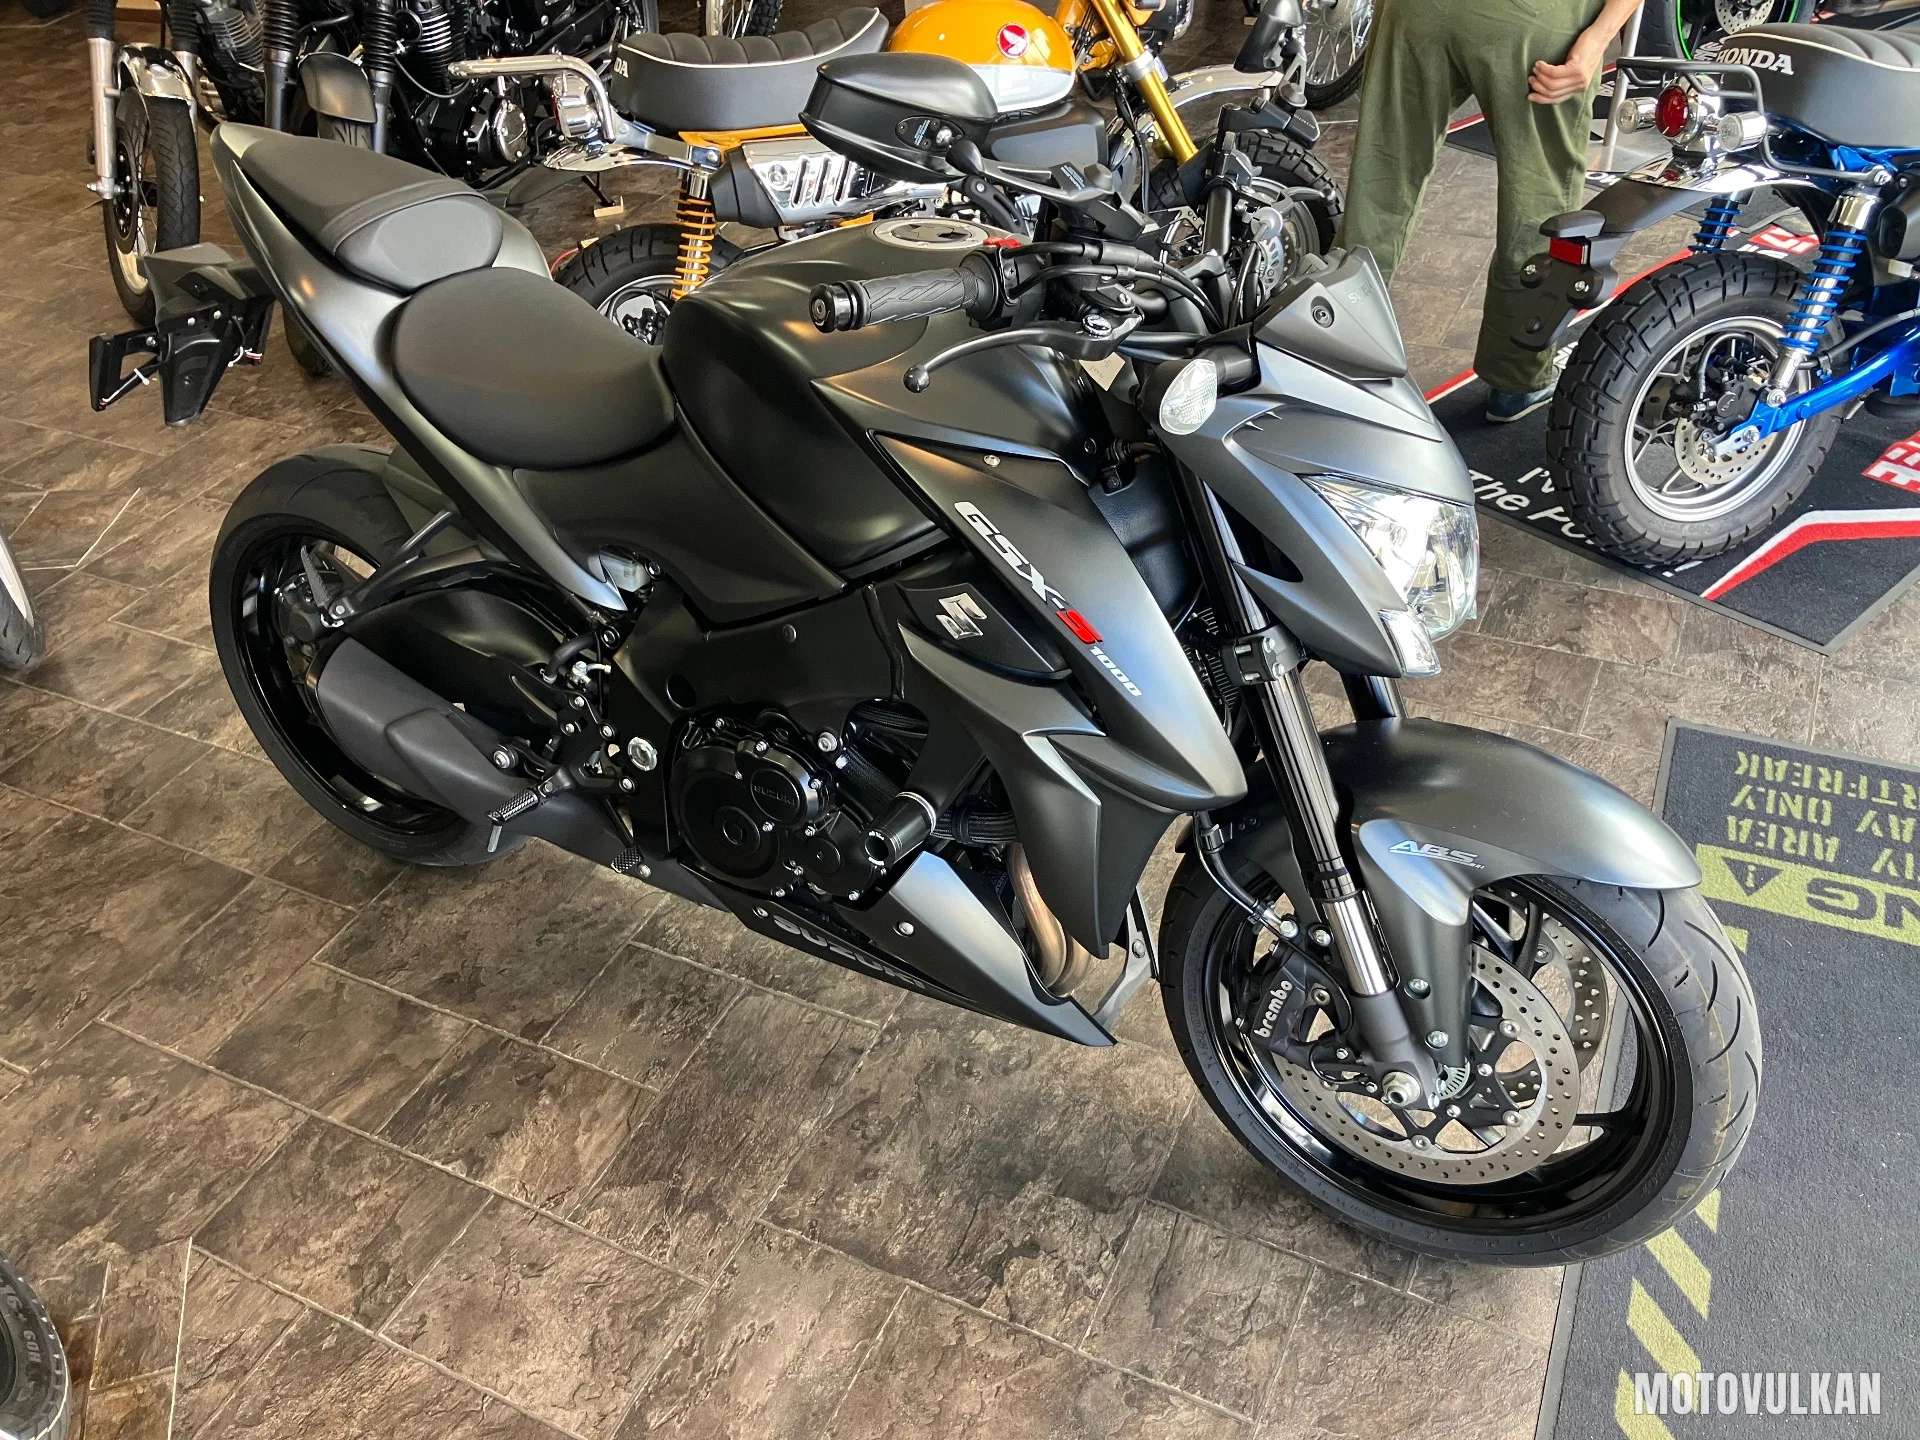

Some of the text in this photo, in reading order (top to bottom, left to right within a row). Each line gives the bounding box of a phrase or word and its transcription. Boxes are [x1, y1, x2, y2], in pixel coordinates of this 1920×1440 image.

[1715, 47, 1795, 76] HONDA
[954, 501, 1104, 645] GSX-S
[1089, 645, 1143, 697] 1000
[1730, 784, 1833, 827] ONLY
[1388, 840, 1479, 865] ABS
[1726, 814, 1841, 863] AREA
[773, 914, 927, 990] SUZUKI
[1253, 980, 1293, 1038] brembo
